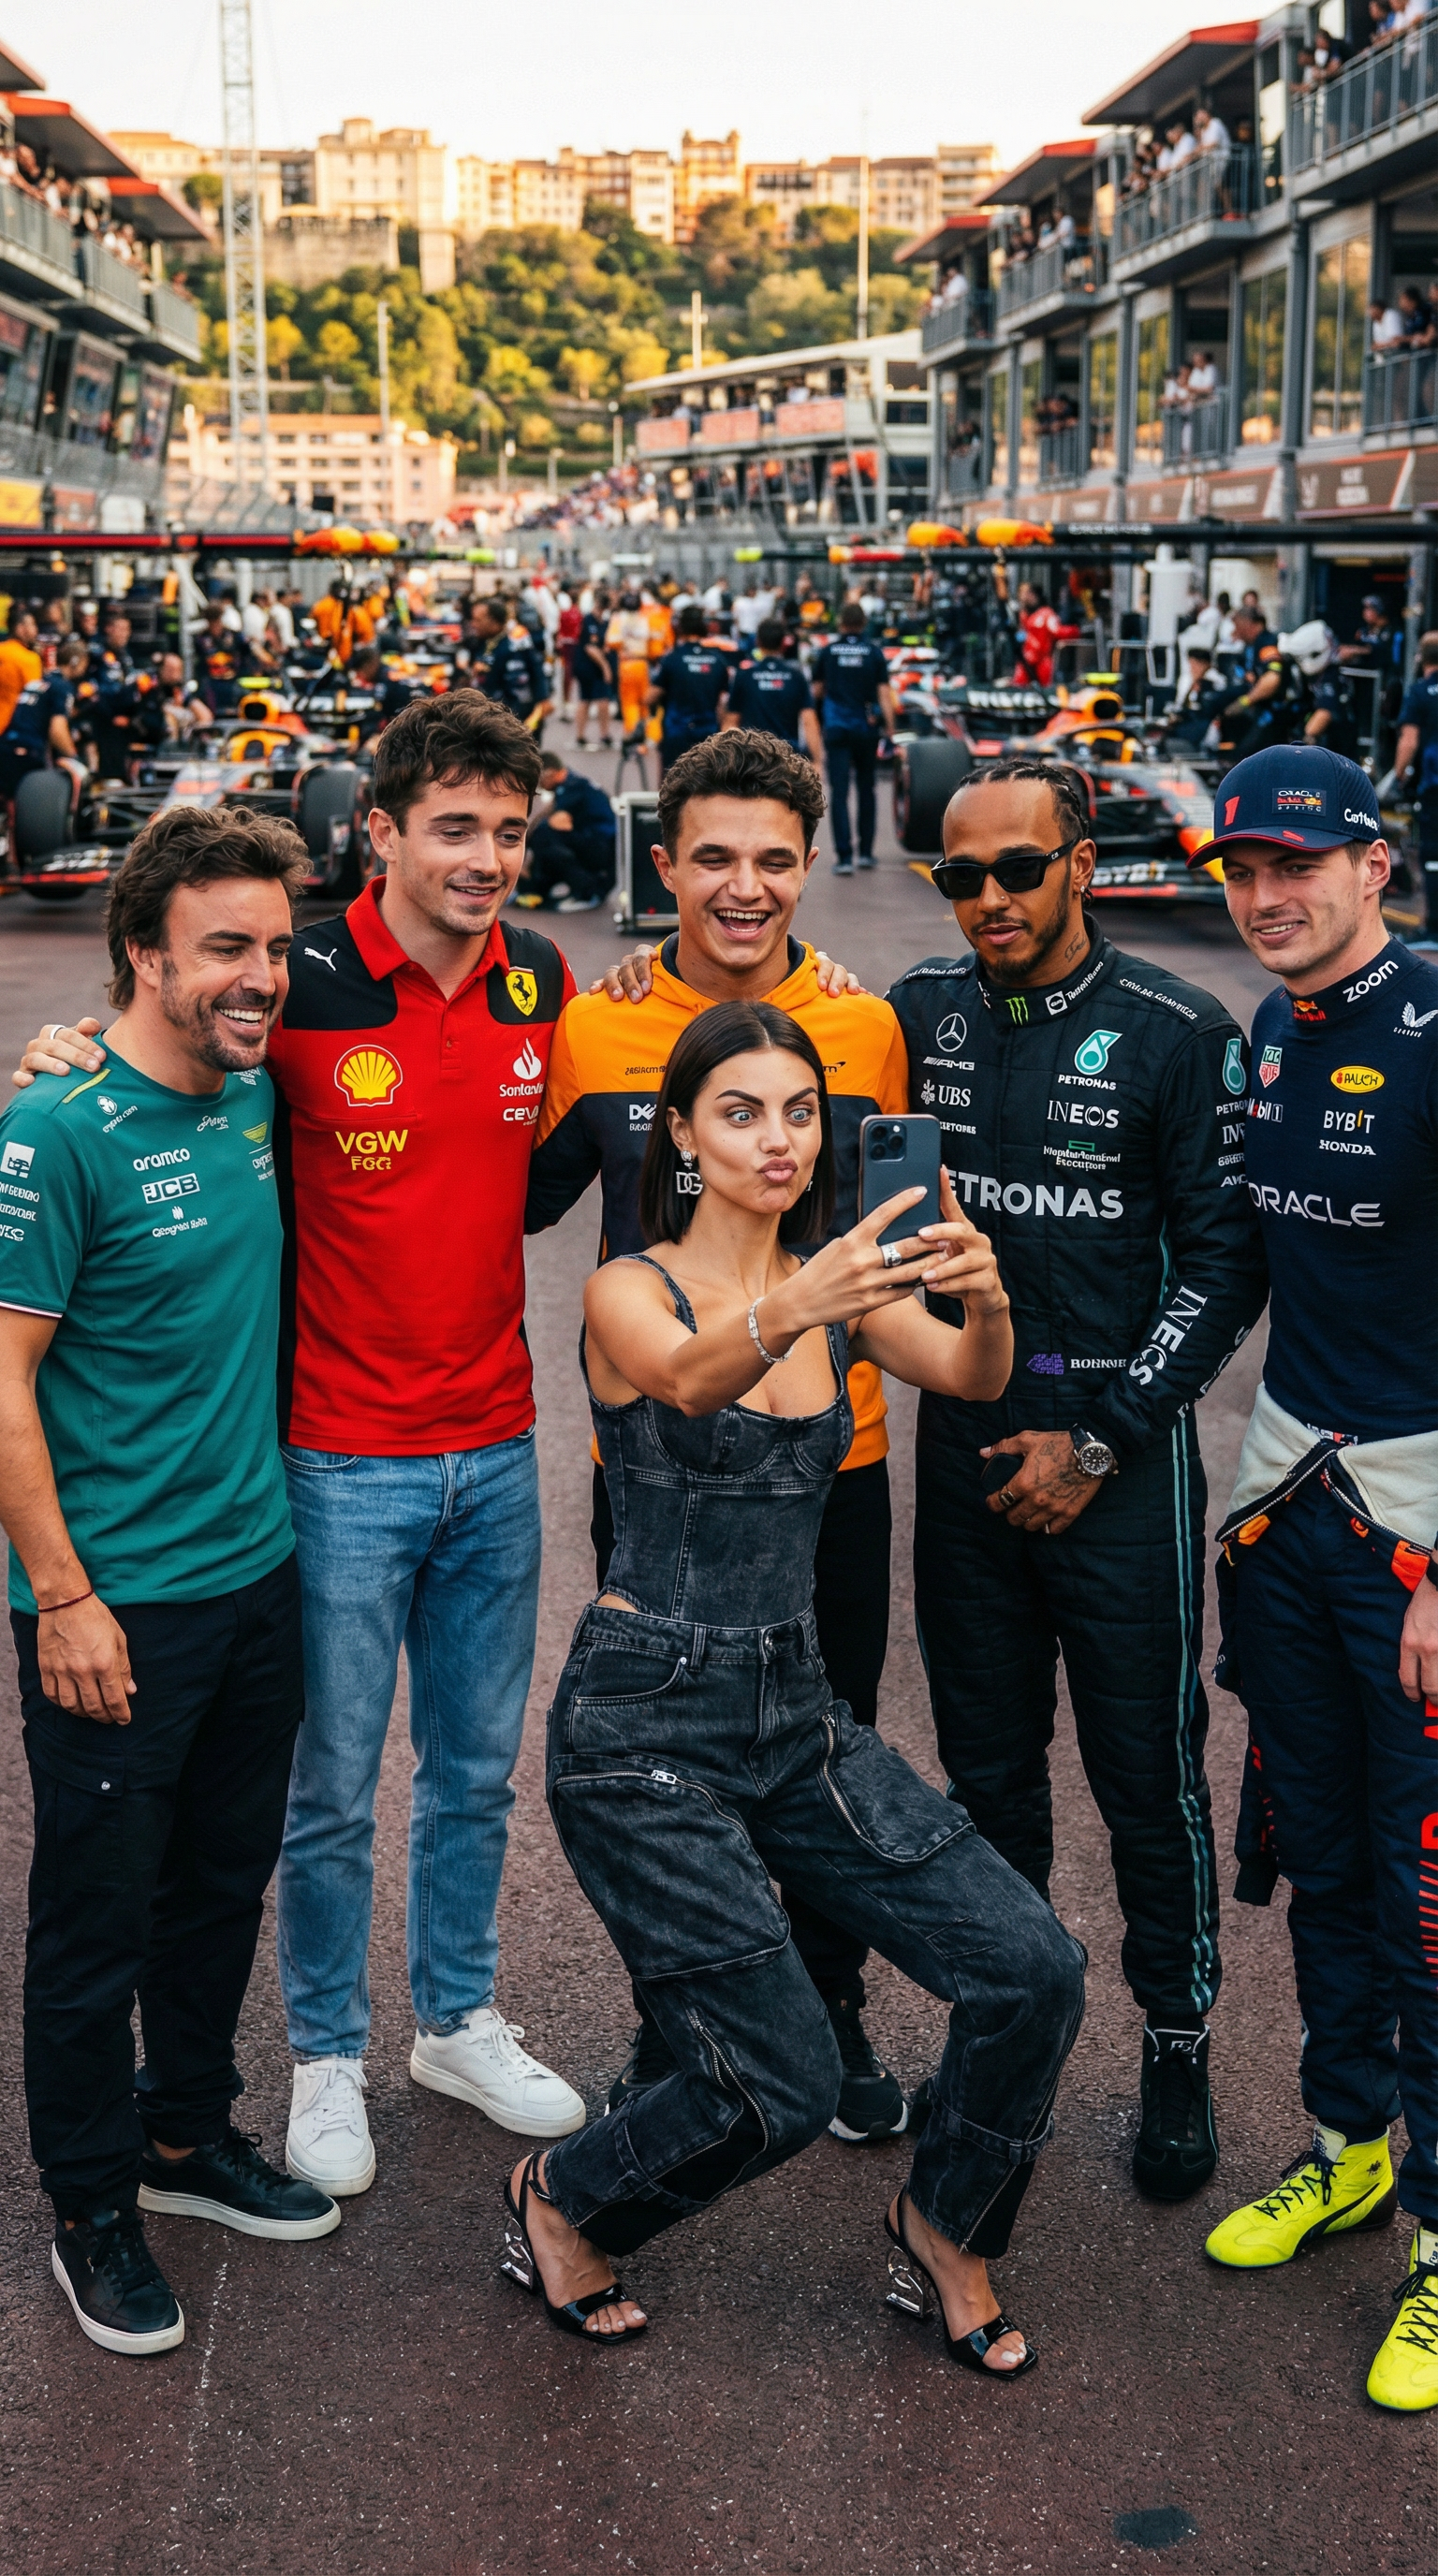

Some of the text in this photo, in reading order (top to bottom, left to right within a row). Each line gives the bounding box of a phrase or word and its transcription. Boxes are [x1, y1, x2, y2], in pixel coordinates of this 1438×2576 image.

[1343, 959, 1399, 1003] zoom
[938, 1084, 971, 1107] UBS
[629, 1104, 657, 1120] DE
[1047, 1100, 1120, 1129] INEOS
[1323, 1109, 1375, 1134] BYBIT
[335, 1129, 408, 1154] VGW
[1318, 1139, 1376, 1156] HONDA
[133, 1148, 191, 1171] aramco
[144, 1175, 199, 1203] JCB
[676, 1171, 703, 1195] DG
[947, 1169, 1123, 1220] ETRONAS
[1248, 1182, 1386, 1227] ORACLE
